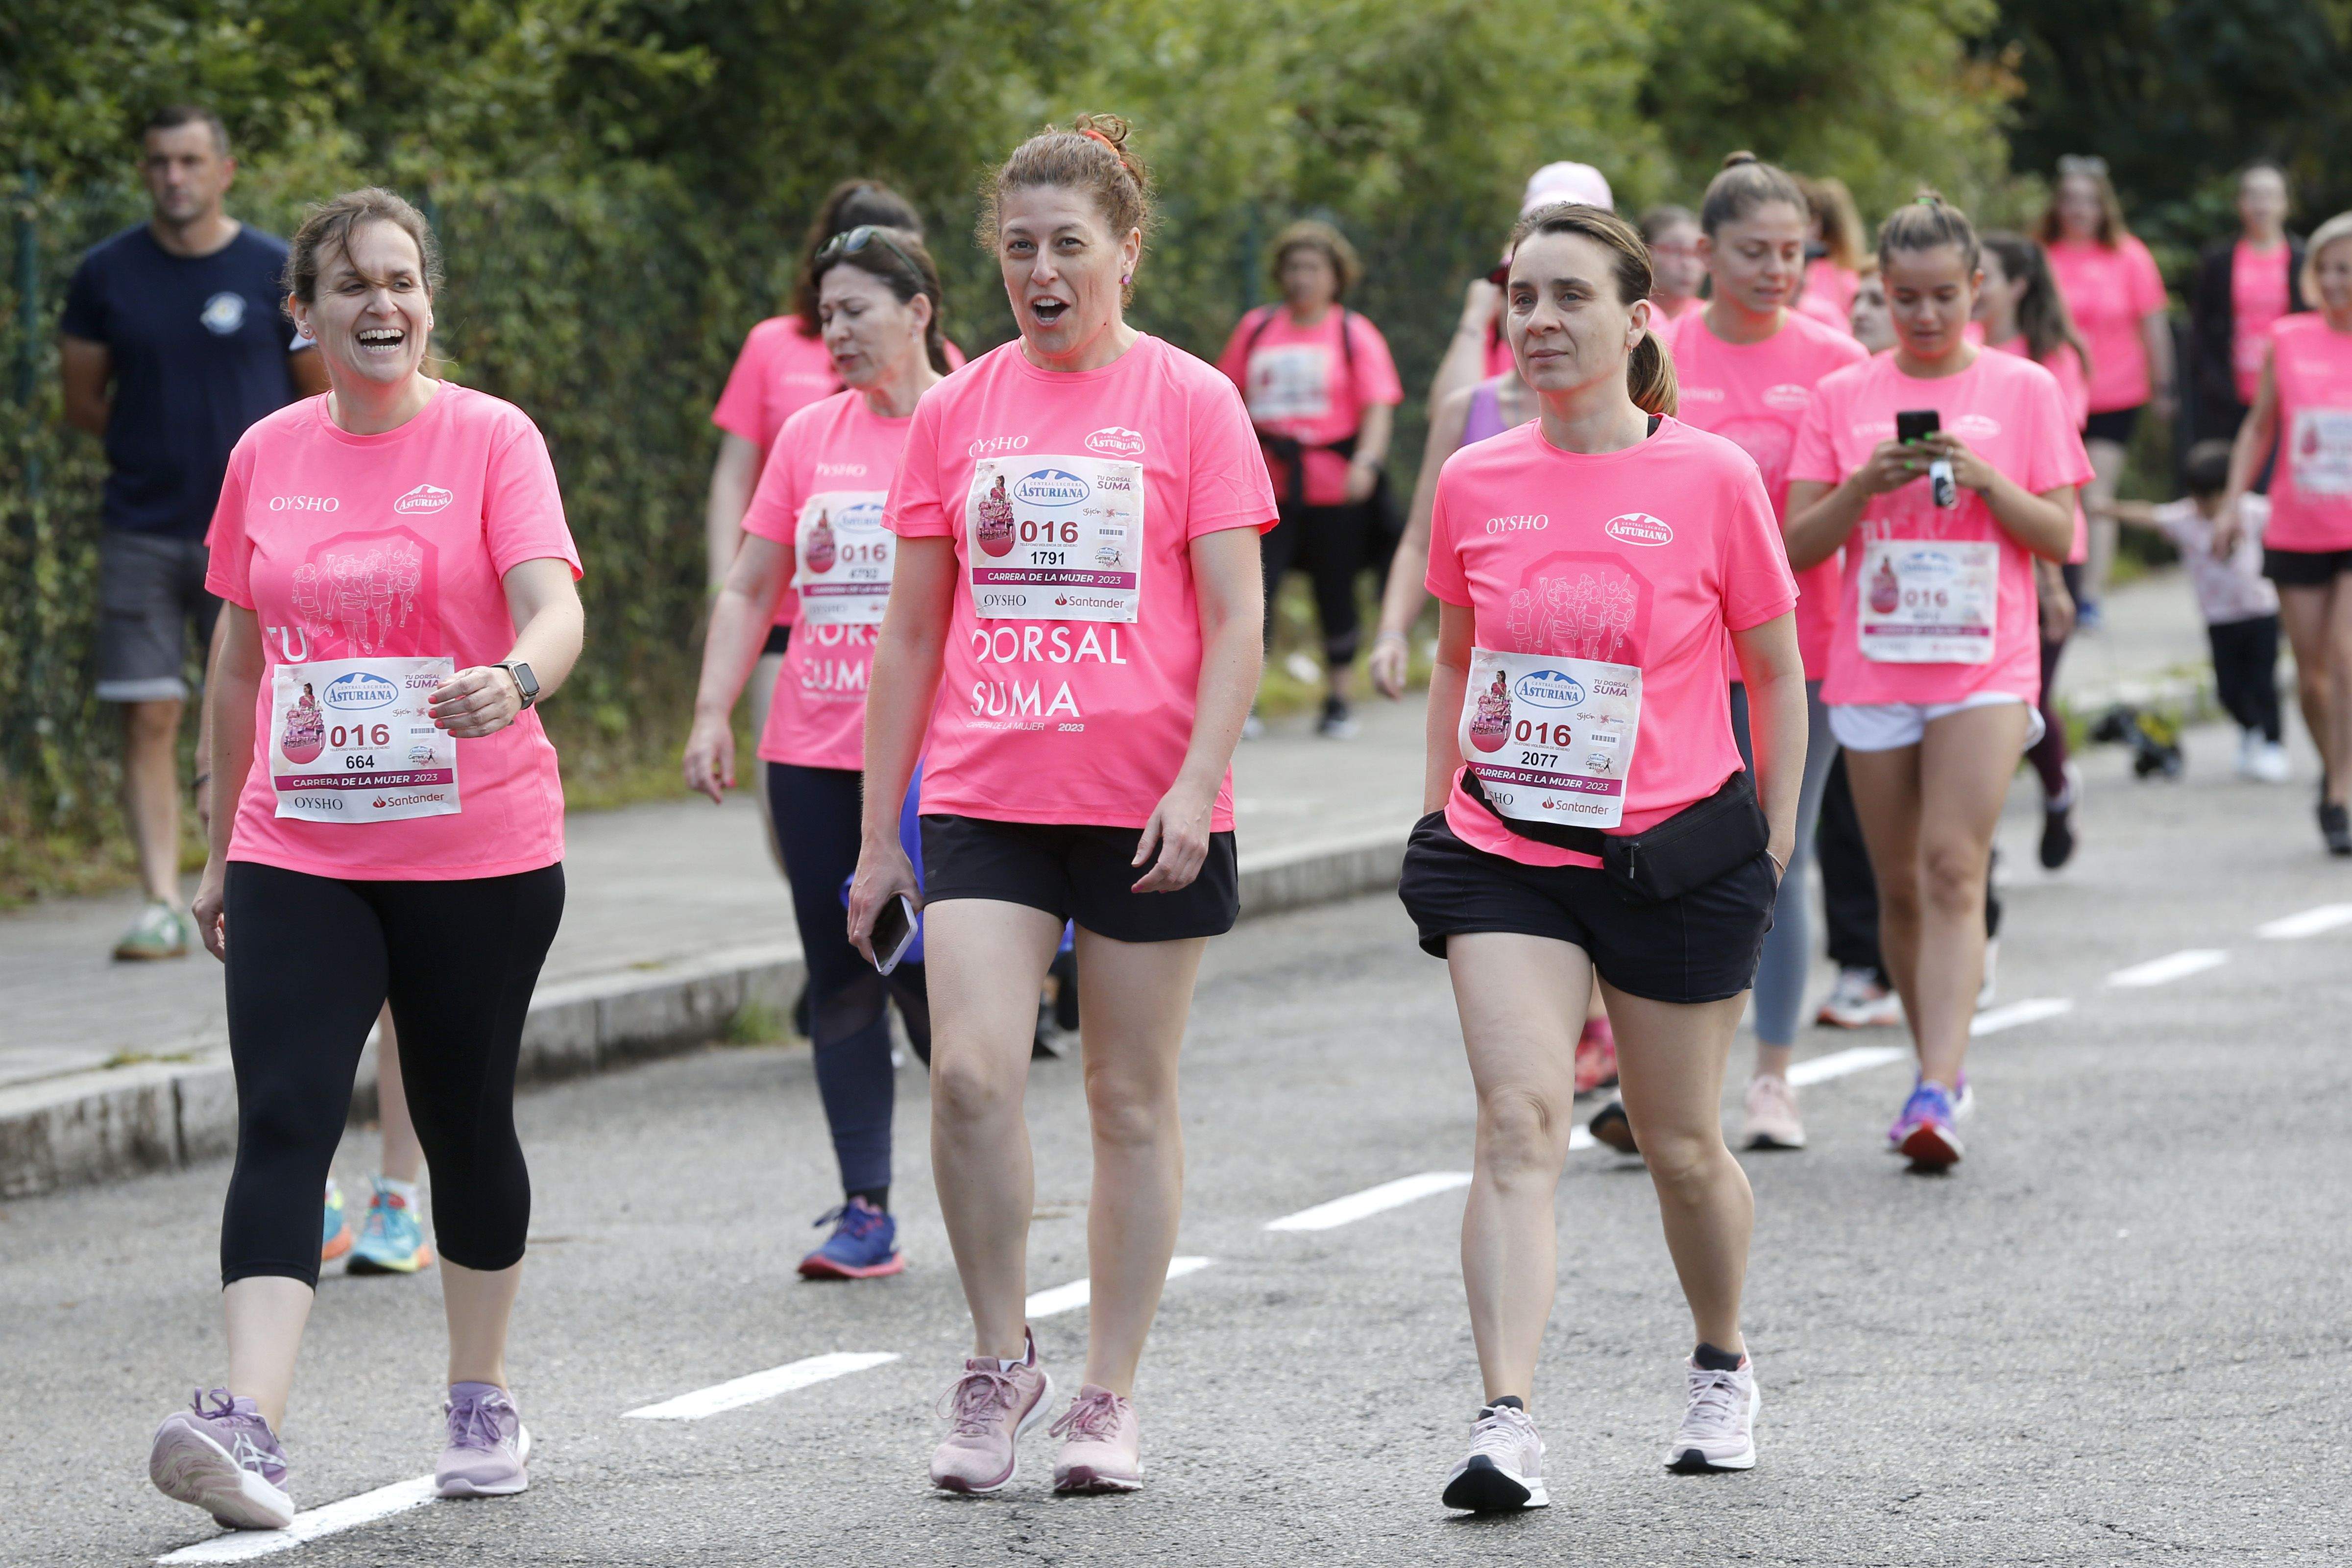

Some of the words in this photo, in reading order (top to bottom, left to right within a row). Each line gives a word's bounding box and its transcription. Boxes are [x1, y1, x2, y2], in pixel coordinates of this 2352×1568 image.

[1090, 436, 1140, 451] ASTURIANA
[1018, 483, 1083, 498] ASTURIANA
[1097, 481, 1131, 491] SUMA
[269, 496, 339, 512] OYSHO
[398, 497, 448, 510] ASTURIANA
[1020, 521, 1079, 543] 016
[1486, 514, 1549, 535] OYSHO
[1610, 522, 1668, 541] ASTURIANA
[842, 544, 887, 562] 016
[1031, 551, 1065, 564] 1791
[988, 573, 1026, 581] CARRERA
[1028, 573, 1043, 581] DE
[1044, 574, 1057, 582] LA
[1060, 574, 1094, 583] MUJER
[1097, 575, 1121, 584] 2023
[984, 594, 1026, 606] OYSHO
[1069, 596, 1124, 608] Santander
[971, 625, 1126, 665] DORSAL
[405, 680, 439, 688] SUMA
[1519, 681, 1578, 701] ASTURIANA
[1593, 685, 1628, 698] SUMA
[328, 689, 392, 702] ASTURIANA
[970, 679, 1080, 717] SUMA
[1013, 722, 1044, 730] MUJER
[1058, 723, 1085, 732] 2023
[1515, 720, 1571, 747] 016
[330, 724, 390, 748] 016
[346, 755, 374, 769] 664
[1521, 751, 1558, 768] 2077
[293, 778, 339, 787] CARRERA
[341, 777, 356, 786] DE
[358, 776, 371, 785] LA
[374, 775, 410, 784] MUJER
[414, 773, 437, 782] 2023
[1475, 767, 1516, 780] CARRERA
[1518, 773, 1532, 782] DE
[1549, 778, 1583, 788] MUJER
[1586, 781, 1609, 791] 2023
[295, 796, 342, 810] OYSHO
[388, 794, 444, 807] Santander
[1556, 800, 1609, 815] Santander
